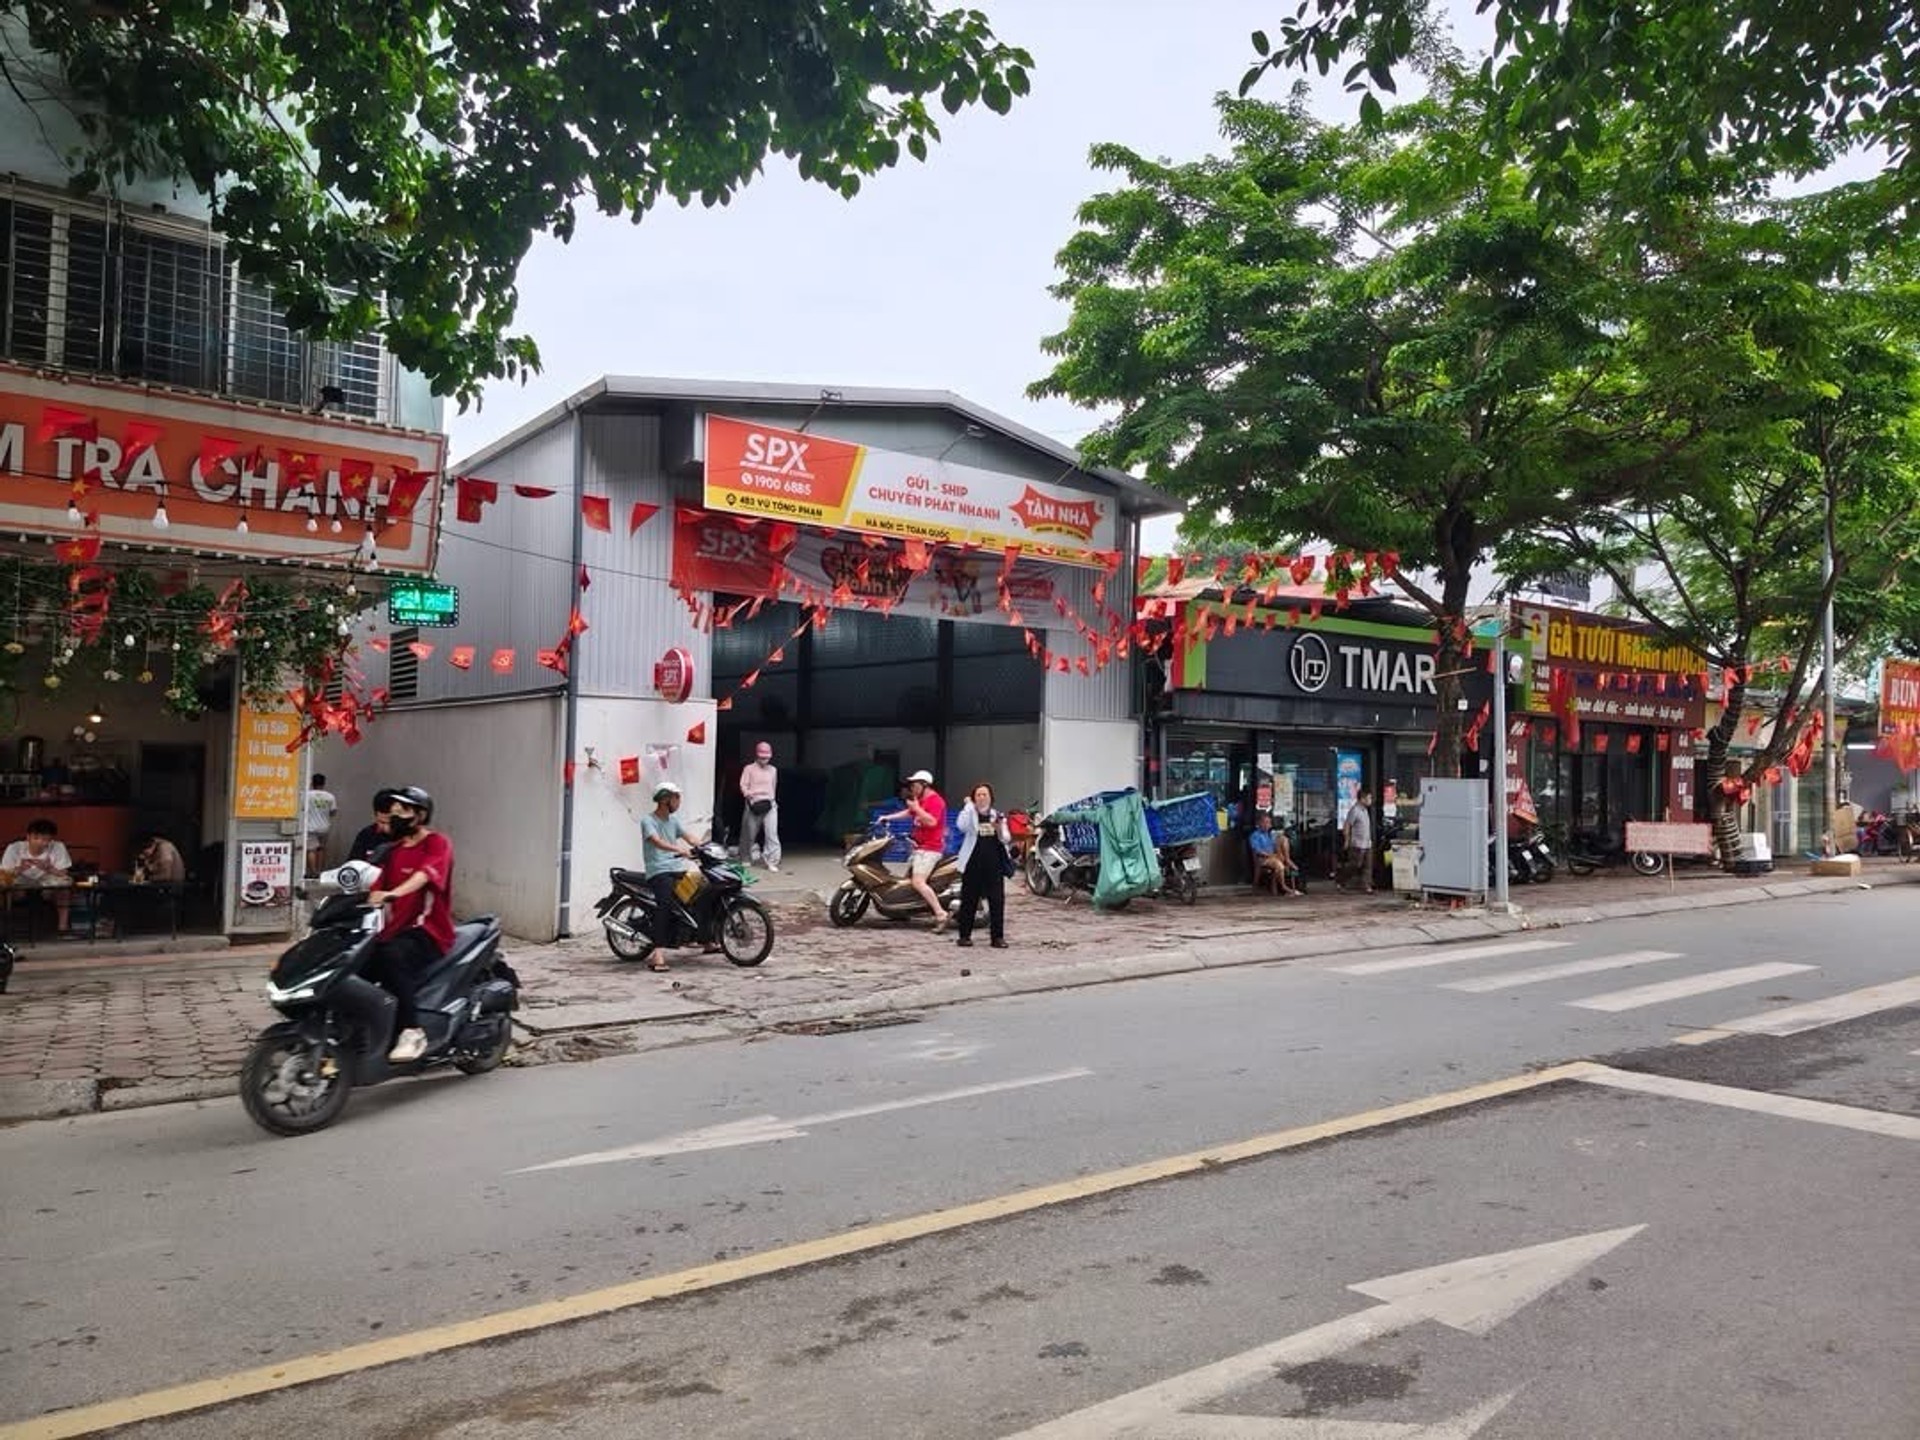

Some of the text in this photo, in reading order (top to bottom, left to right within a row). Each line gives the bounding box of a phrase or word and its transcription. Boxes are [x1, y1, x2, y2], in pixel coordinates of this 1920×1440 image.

[744, 433, 810, 474] SPX
[754, 474, 782, 490] 1900
[940, 483, 968, 497] SHIP
[957, 504, 1001, 520] NHANH
[1057, 504, 1091, 527] NHÀ
[701, 527, 760, 560] SPX
[1550, 615, 1573, 659] GÀ
